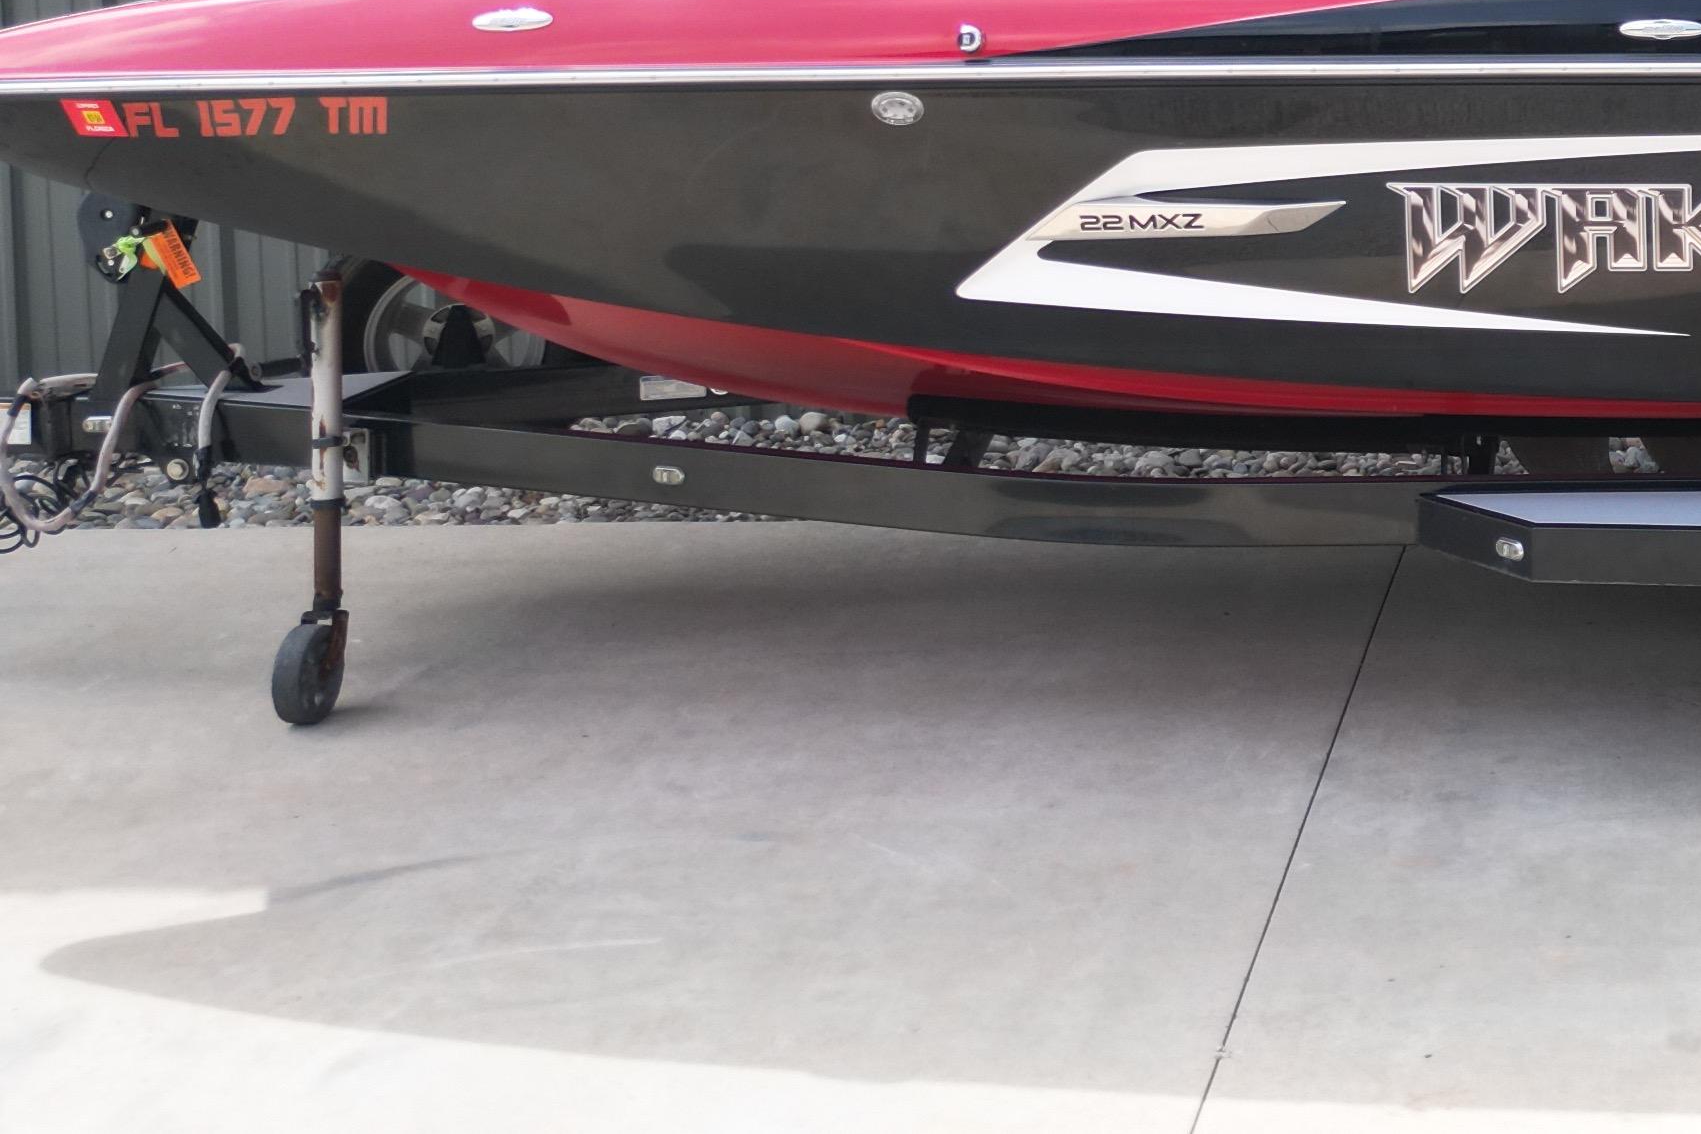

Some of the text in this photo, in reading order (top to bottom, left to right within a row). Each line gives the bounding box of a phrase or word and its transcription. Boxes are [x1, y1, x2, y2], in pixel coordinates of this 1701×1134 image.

[122, 96, 388, 137] FL 1577 TM
